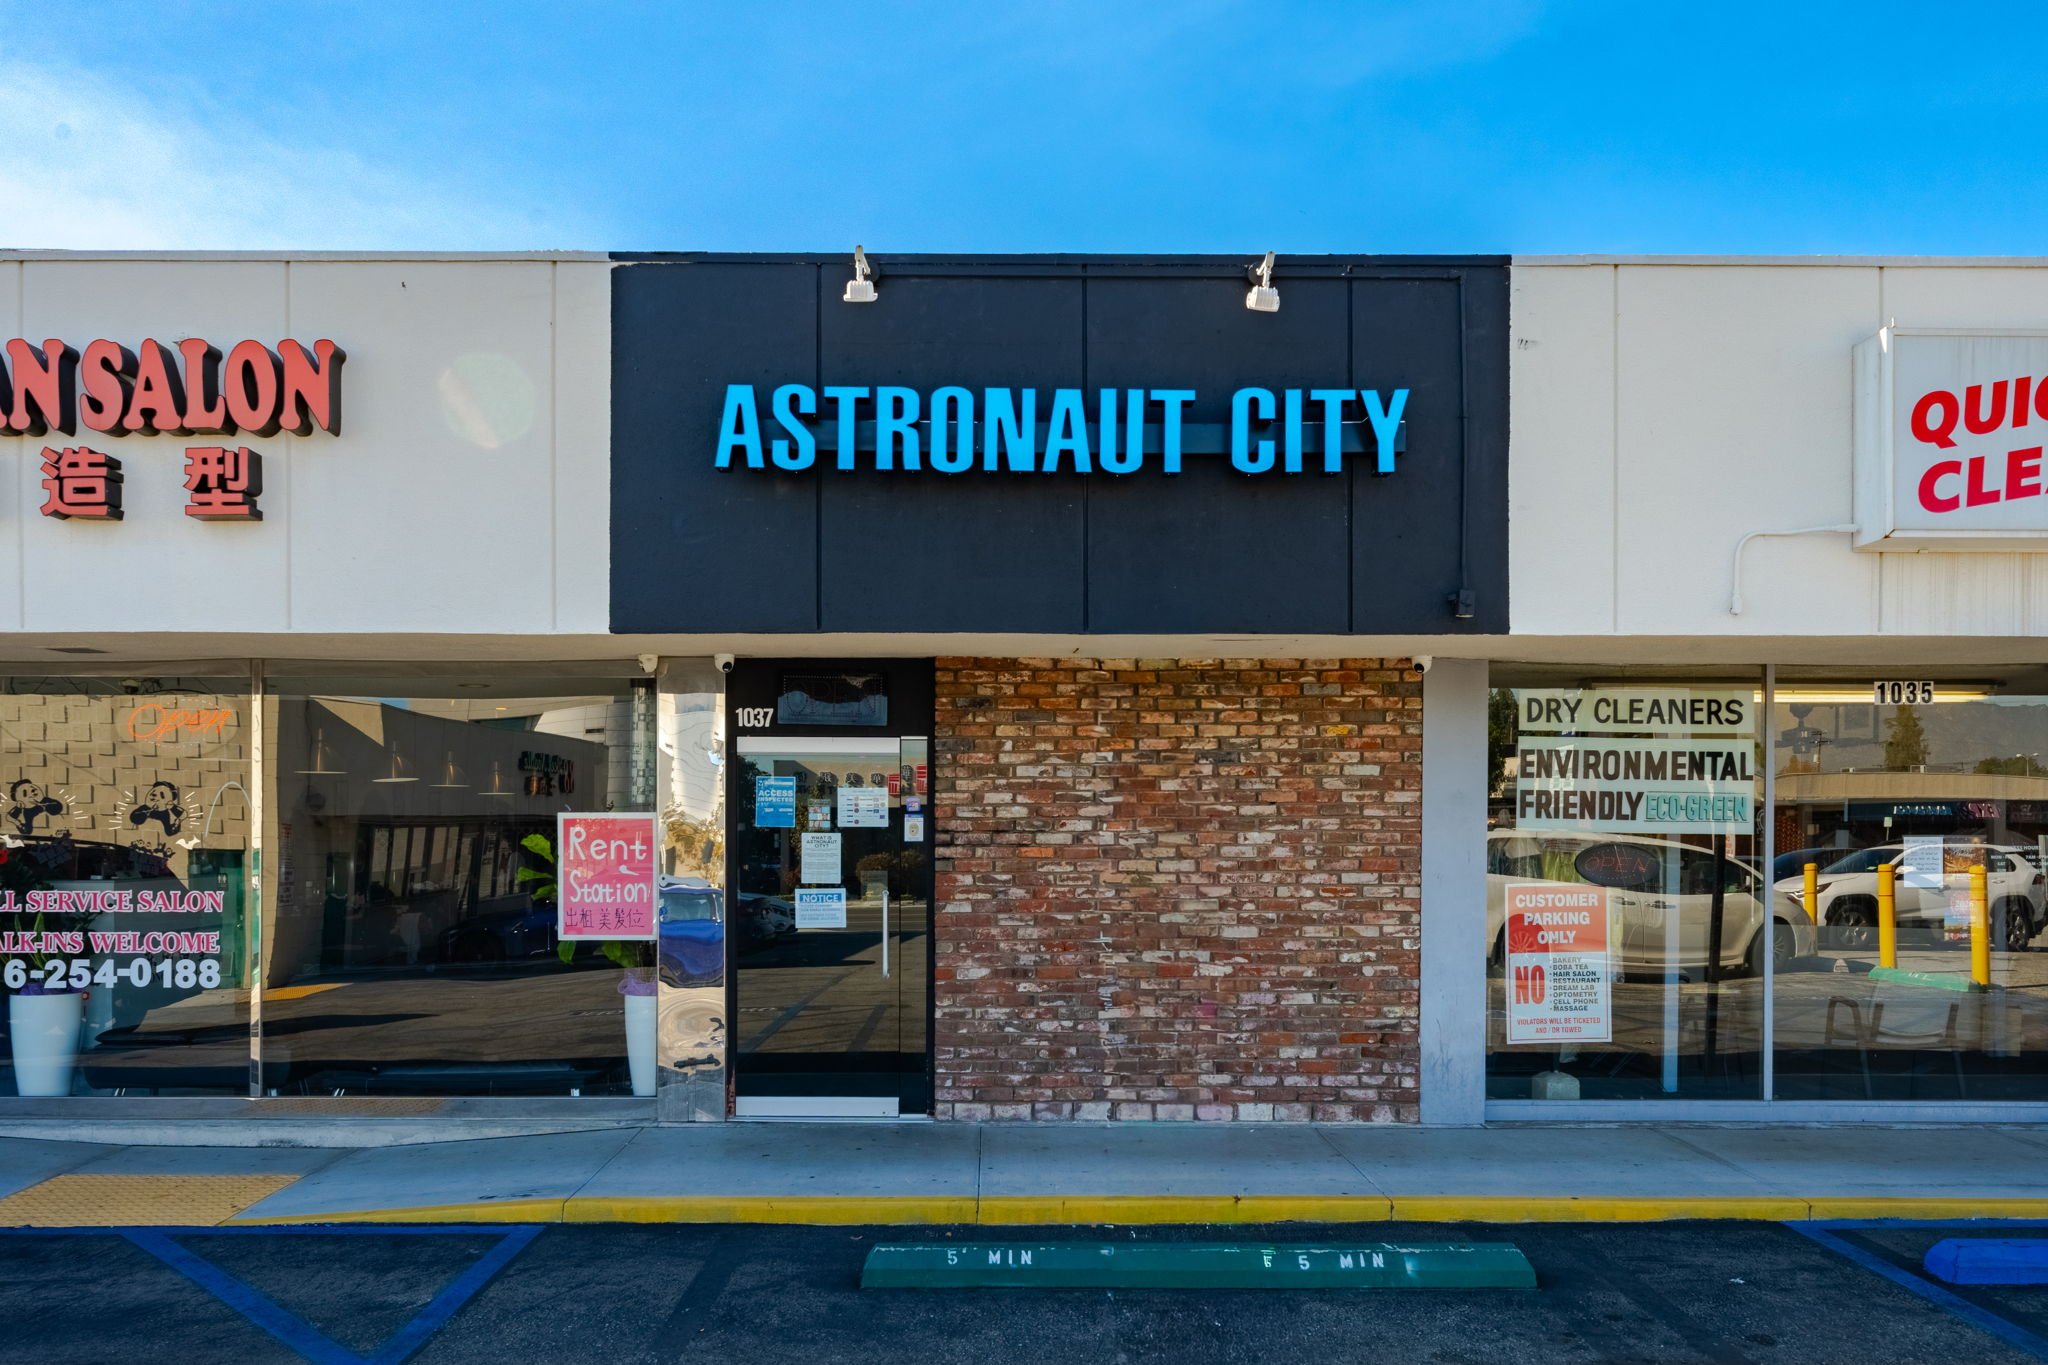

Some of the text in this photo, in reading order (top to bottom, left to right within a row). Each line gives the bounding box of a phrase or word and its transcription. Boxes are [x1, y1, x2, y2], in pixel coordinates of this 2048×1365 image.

[80, 337, 341, 434] SALON
[714, 384, 1410, 474] ASTRONAUT CITY
[1917, 446, 2048, 514] CLE
[1876, 682, 1933, 704] 1035
[735, 707, 774, 728] 1037
[1526, 697, 1744, 725] DRY CLEANERS
[1519, 749, 1754, 782] ENVIRONMENTAL
[758, 789, 793, 797] ACCESS
[1519, 790, 1748, 822] FRIENDLY ECO-GREEN
[569, 826, 647, 863] Rent
[569, 869, 648, 904] Station
[26, 889, 134, 912] SERVICE
[137, 890, 224, 913] SALON
[802, 894, 839, 903] NOTICE
[1515, 893, 1599, 908] CUSTOMER
[1523, 912, 1590, 926] PARKING
[0, 931, 221, 954] LK-INS WELCOME
[1537, 930, 1576, 944] ONLY
[1515, 964, 1545, 1005] NO
[947, 1249, 1032, 1265] 5 MIN
[1298, 1252, 1385, 1270] 5 MIN
